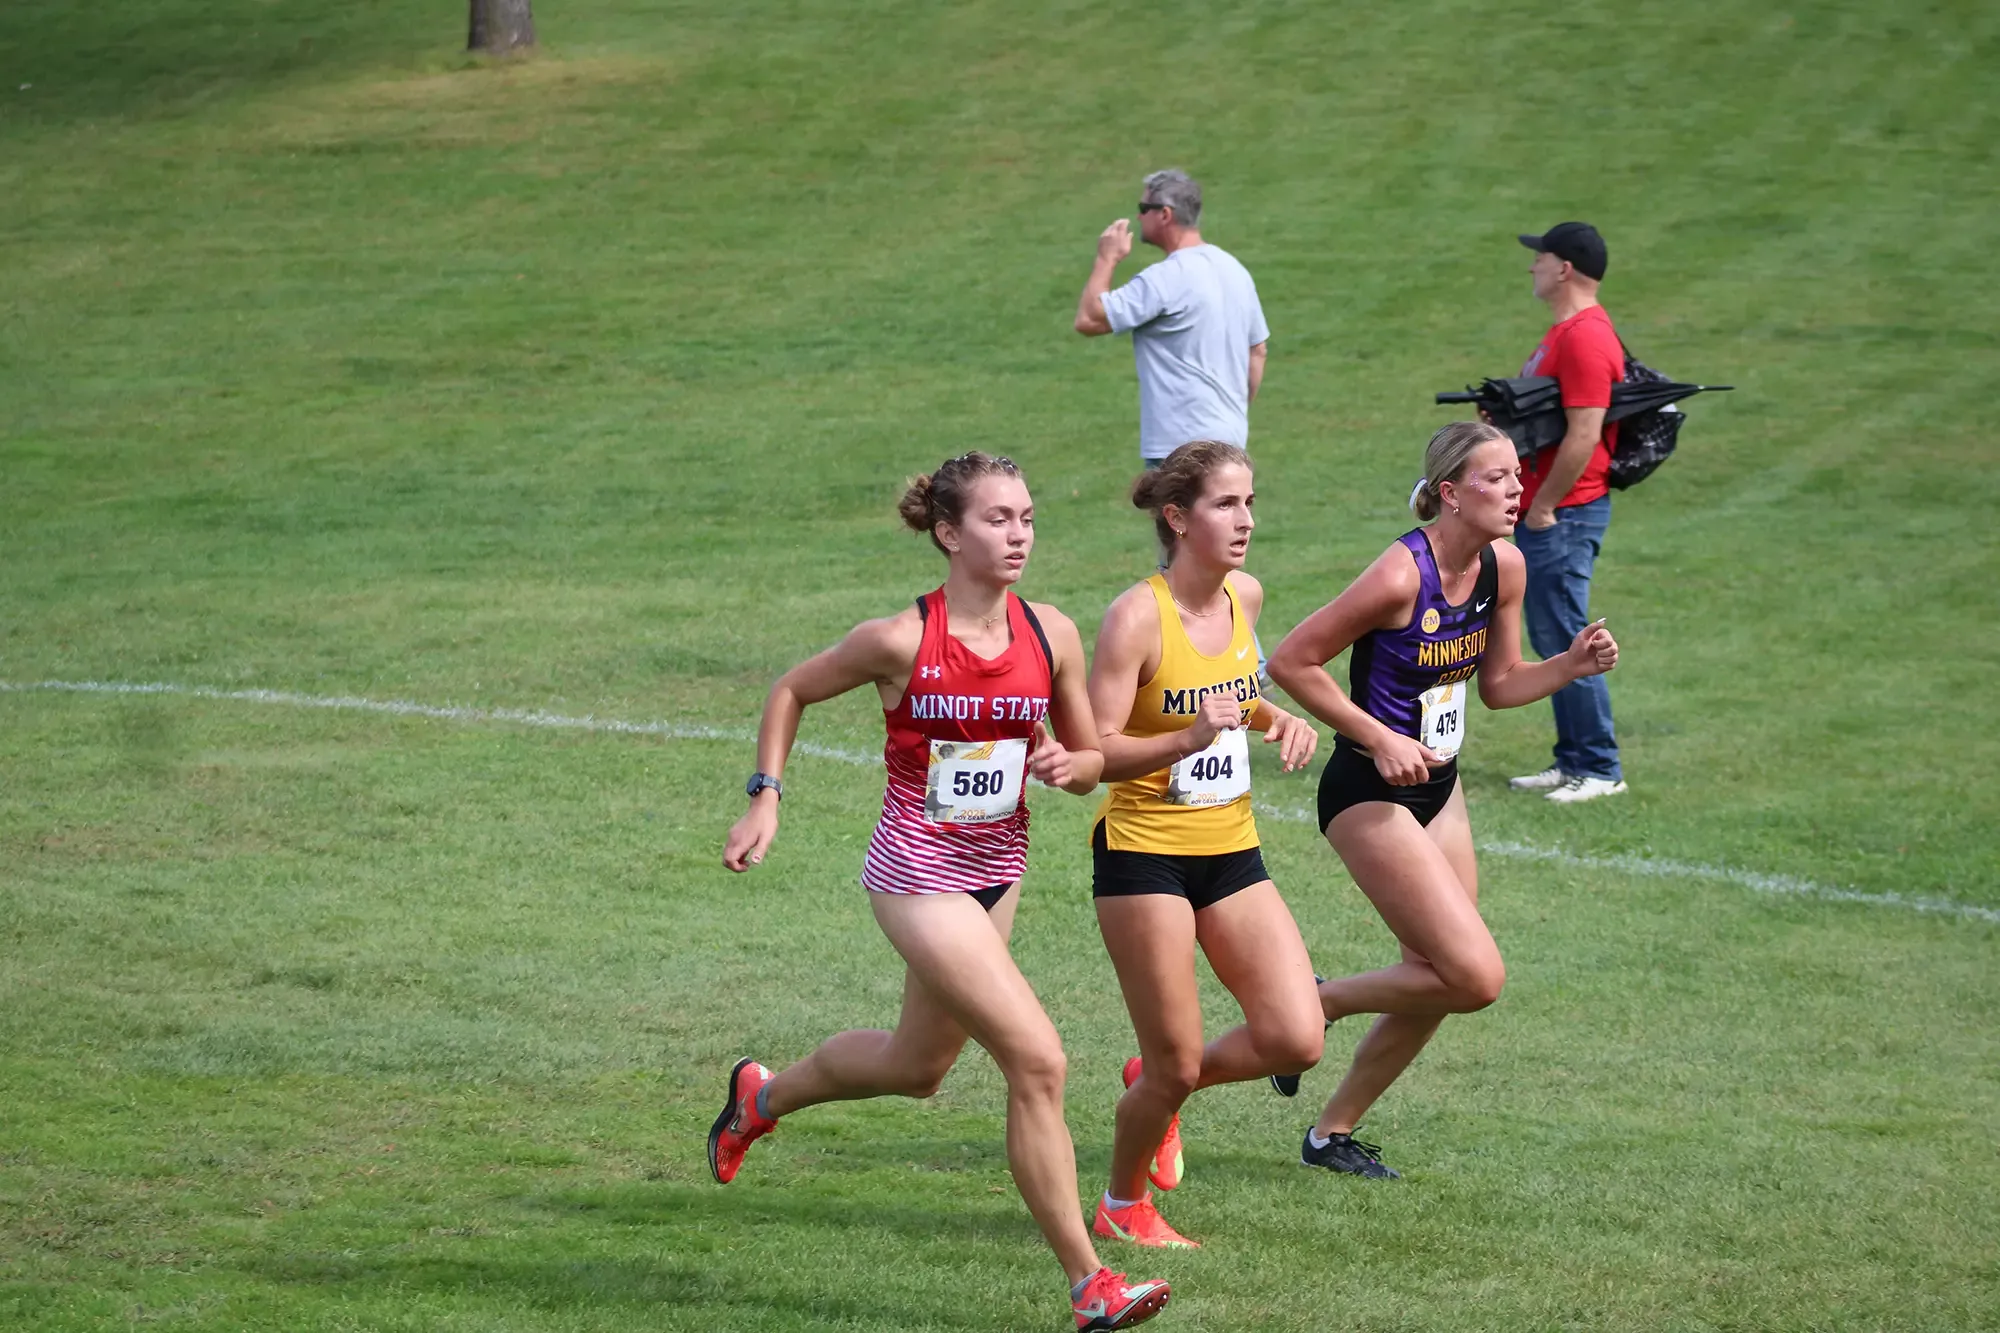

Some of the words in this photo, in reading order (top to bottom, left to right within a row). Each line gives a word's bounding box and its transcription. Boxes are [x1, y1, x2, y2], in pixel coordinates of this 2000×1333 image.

[1424, 615, 1438, 627] FM
[911, 694, 984, 720] MINOT
[991, 697, 1049, 721] STATE
[1435, 709, 1457, 736] 479
[1190, 755, 1233, 781] 404
[952, 769, 1004, 797] 580
[960, 809, 986, 818] 2025
